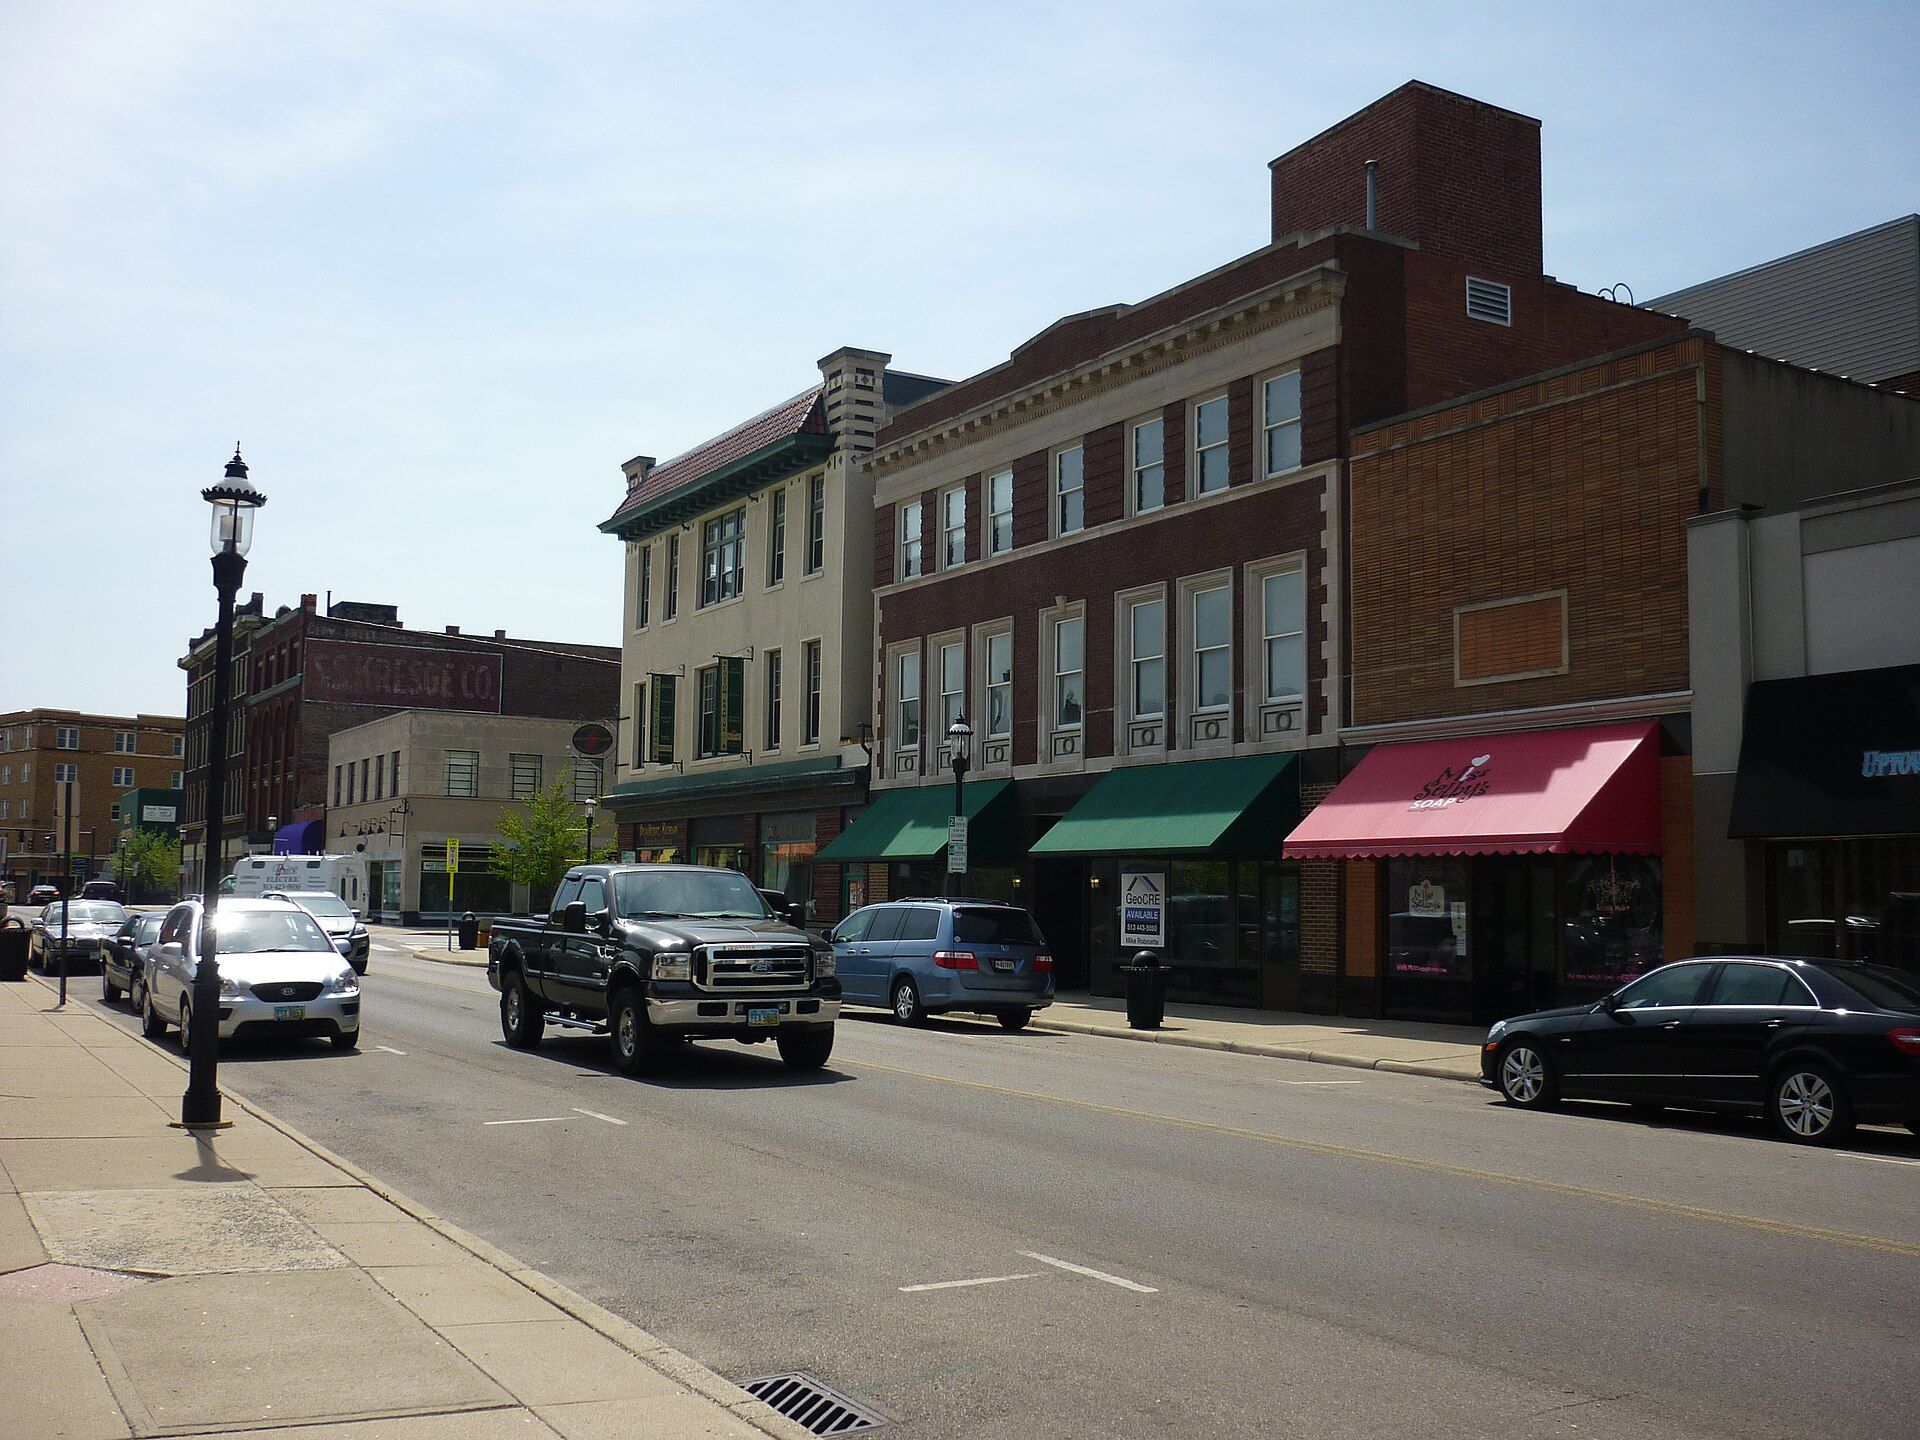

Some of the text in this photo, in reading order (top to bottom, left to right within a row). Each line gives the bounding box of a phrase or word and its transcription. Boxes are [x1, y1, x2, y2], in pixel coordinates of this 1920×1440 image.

[1410, 797, 1457, 809] SOAP
[1126, 892, 1160, 905] GeoCRE
[1126, 910, 1159, 920] AVAILABLE
